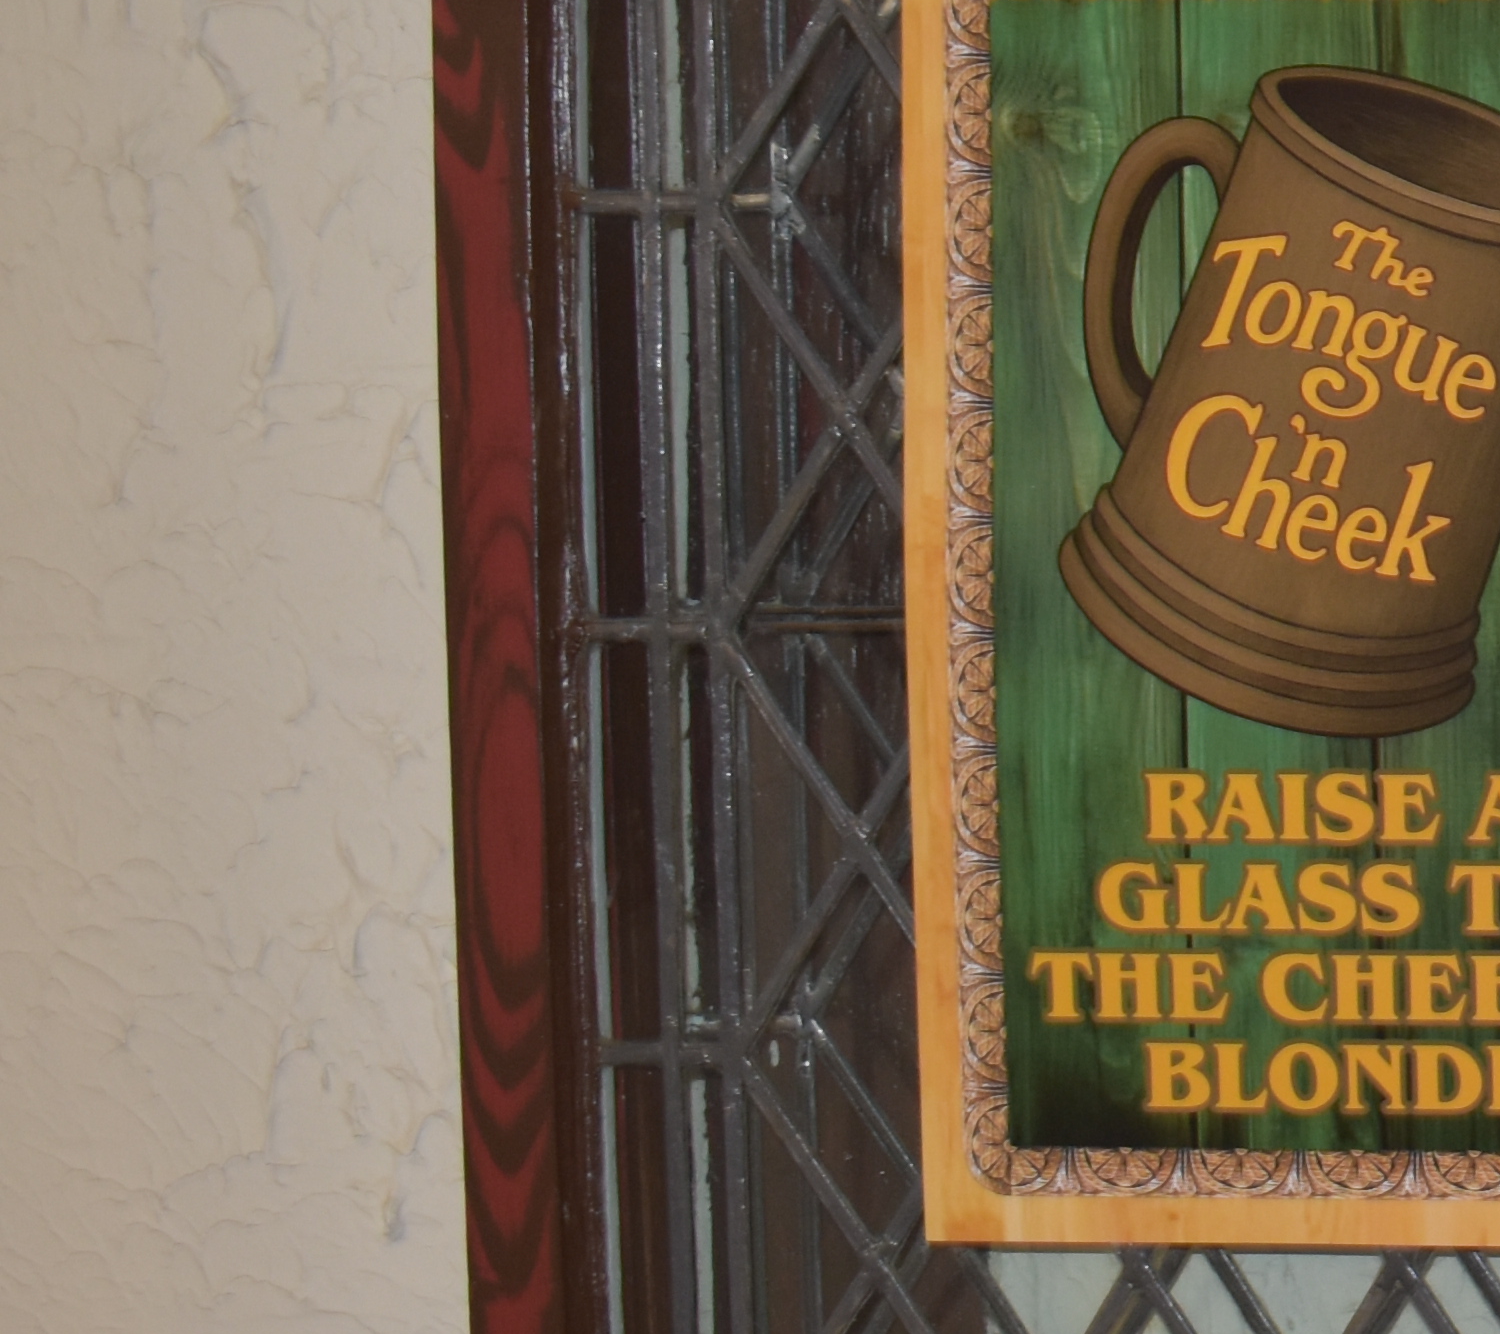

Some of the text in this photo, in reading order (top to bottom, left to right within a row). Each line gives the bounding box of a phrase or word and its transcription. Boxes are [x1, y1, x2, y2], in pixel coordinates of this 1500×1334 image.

[1331, 219, 1436, 298] The
[1199, 233, 1497, 421] Tongue
[1164, 393, 1452, 583] Cheek
[1144, 772, 1441, 844] RAISE
[1097, 861, 1421, 935] GLASS
[1030, 951, 1229, 1022] THE
